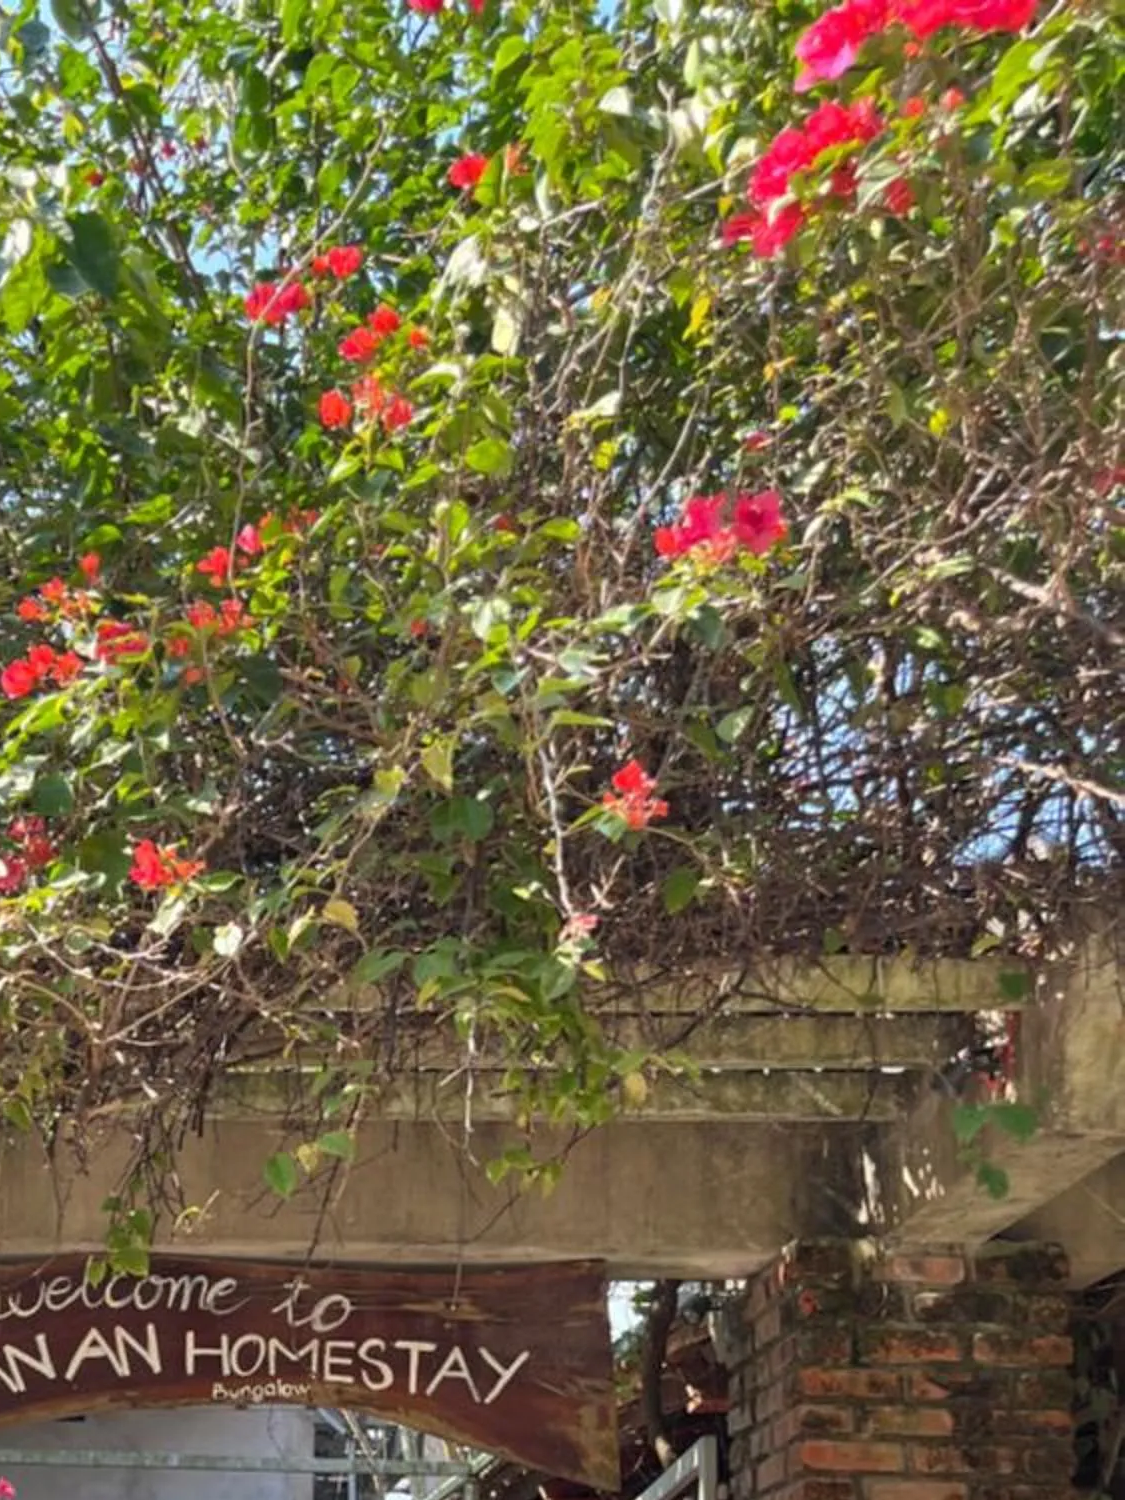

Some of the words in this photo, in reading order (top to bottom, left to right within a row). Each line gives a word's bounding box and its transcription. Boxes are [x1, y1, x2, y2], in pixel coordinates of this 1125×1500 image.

[271, 1278, 352, 1332] to
[64, 1323, 162, 1382] AN
[185, 1330, 530, 1404] HOMESTAY
